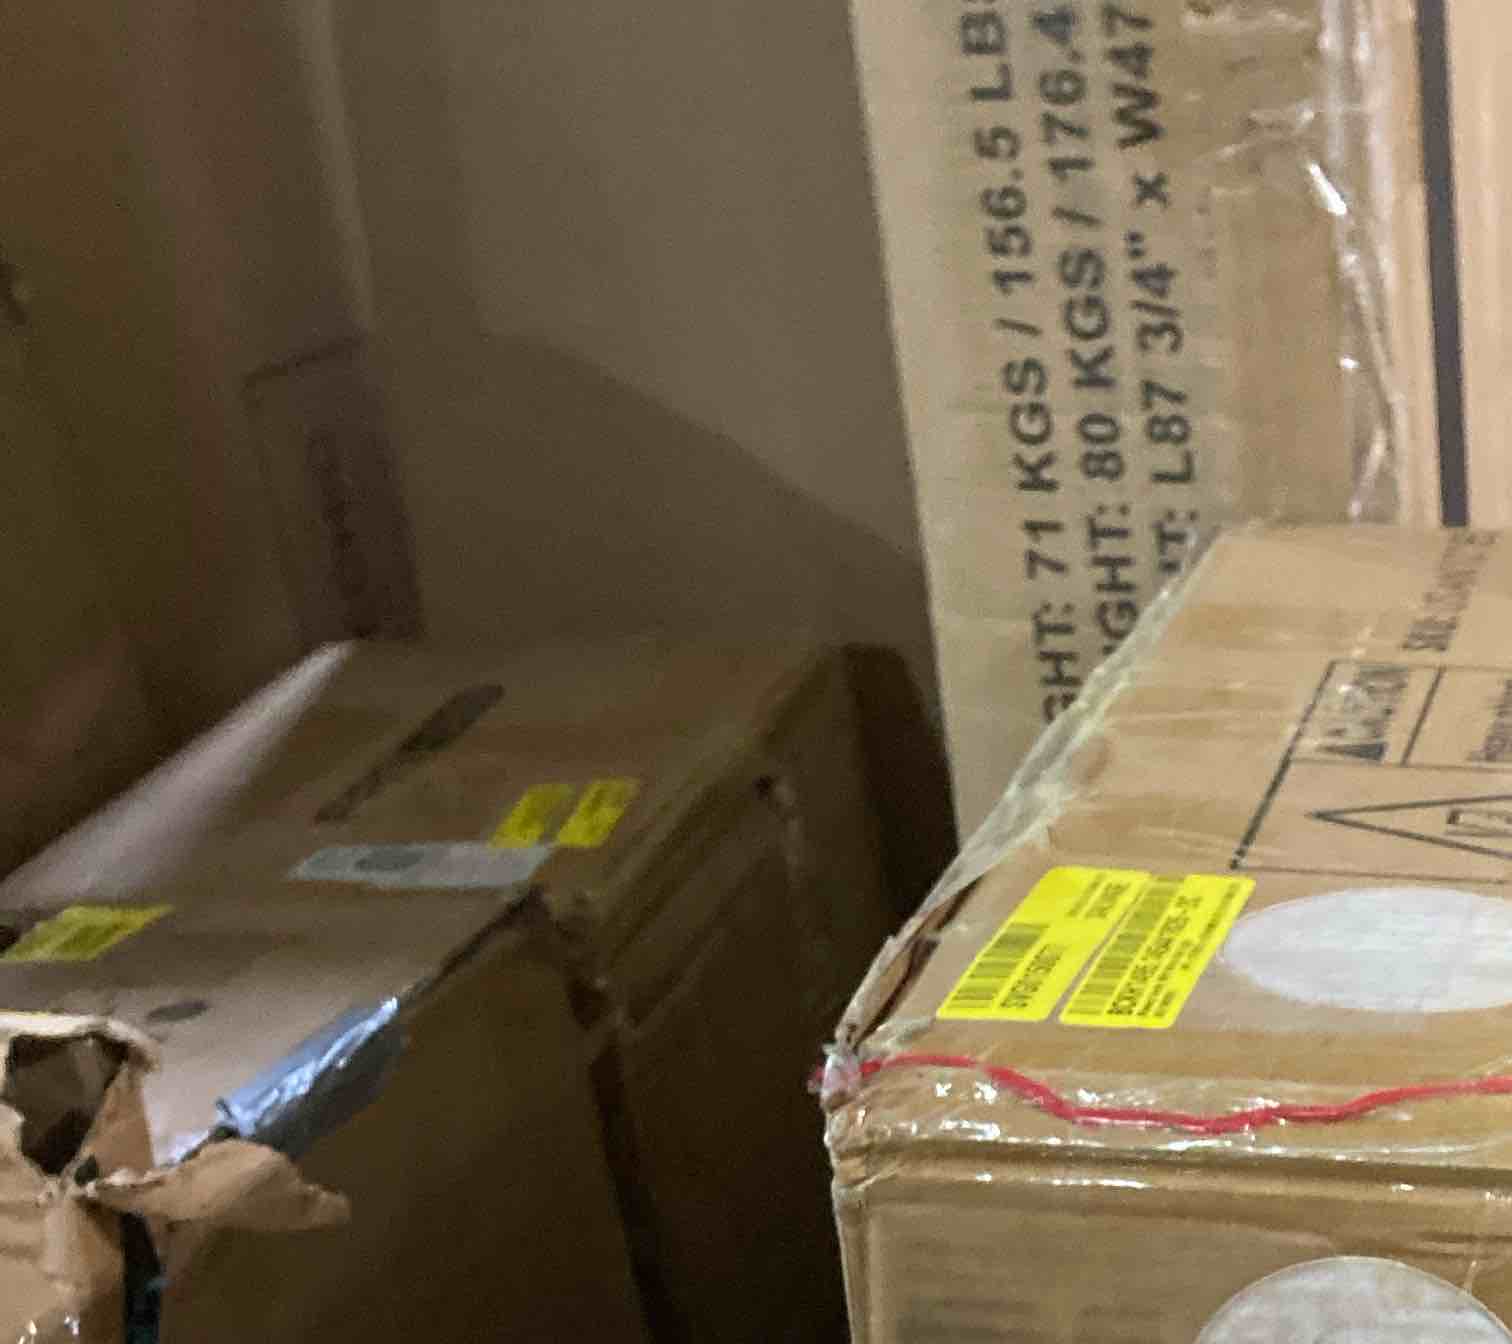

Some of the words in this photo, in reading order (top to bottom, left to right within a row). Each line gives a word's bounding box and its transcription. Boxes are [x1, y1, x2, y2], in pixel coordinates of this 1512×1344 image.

[960, 0, 1013, 102] LB
[1031, 7, 1094, 184] 176.4
[1102, 3, 1167, 150] W47
[973, 125, 1036, 295] 156.5
[1052, 206, 1104, 227] /
[1132, 171, 1171, 208] x
[996, 317, 1042, 336] /
[1058, 248, 1115, 390] KGS
[1124, 230, 1184, 353] 3/4"
[1003, 356, 1060, 492] KGS
[1077, 413, 1125, 482] 80
[1140, 379, 1196, 486] L87
[1022, 520, 1068, 580] 71
[1086, 504, 1139, 655] GHT:
